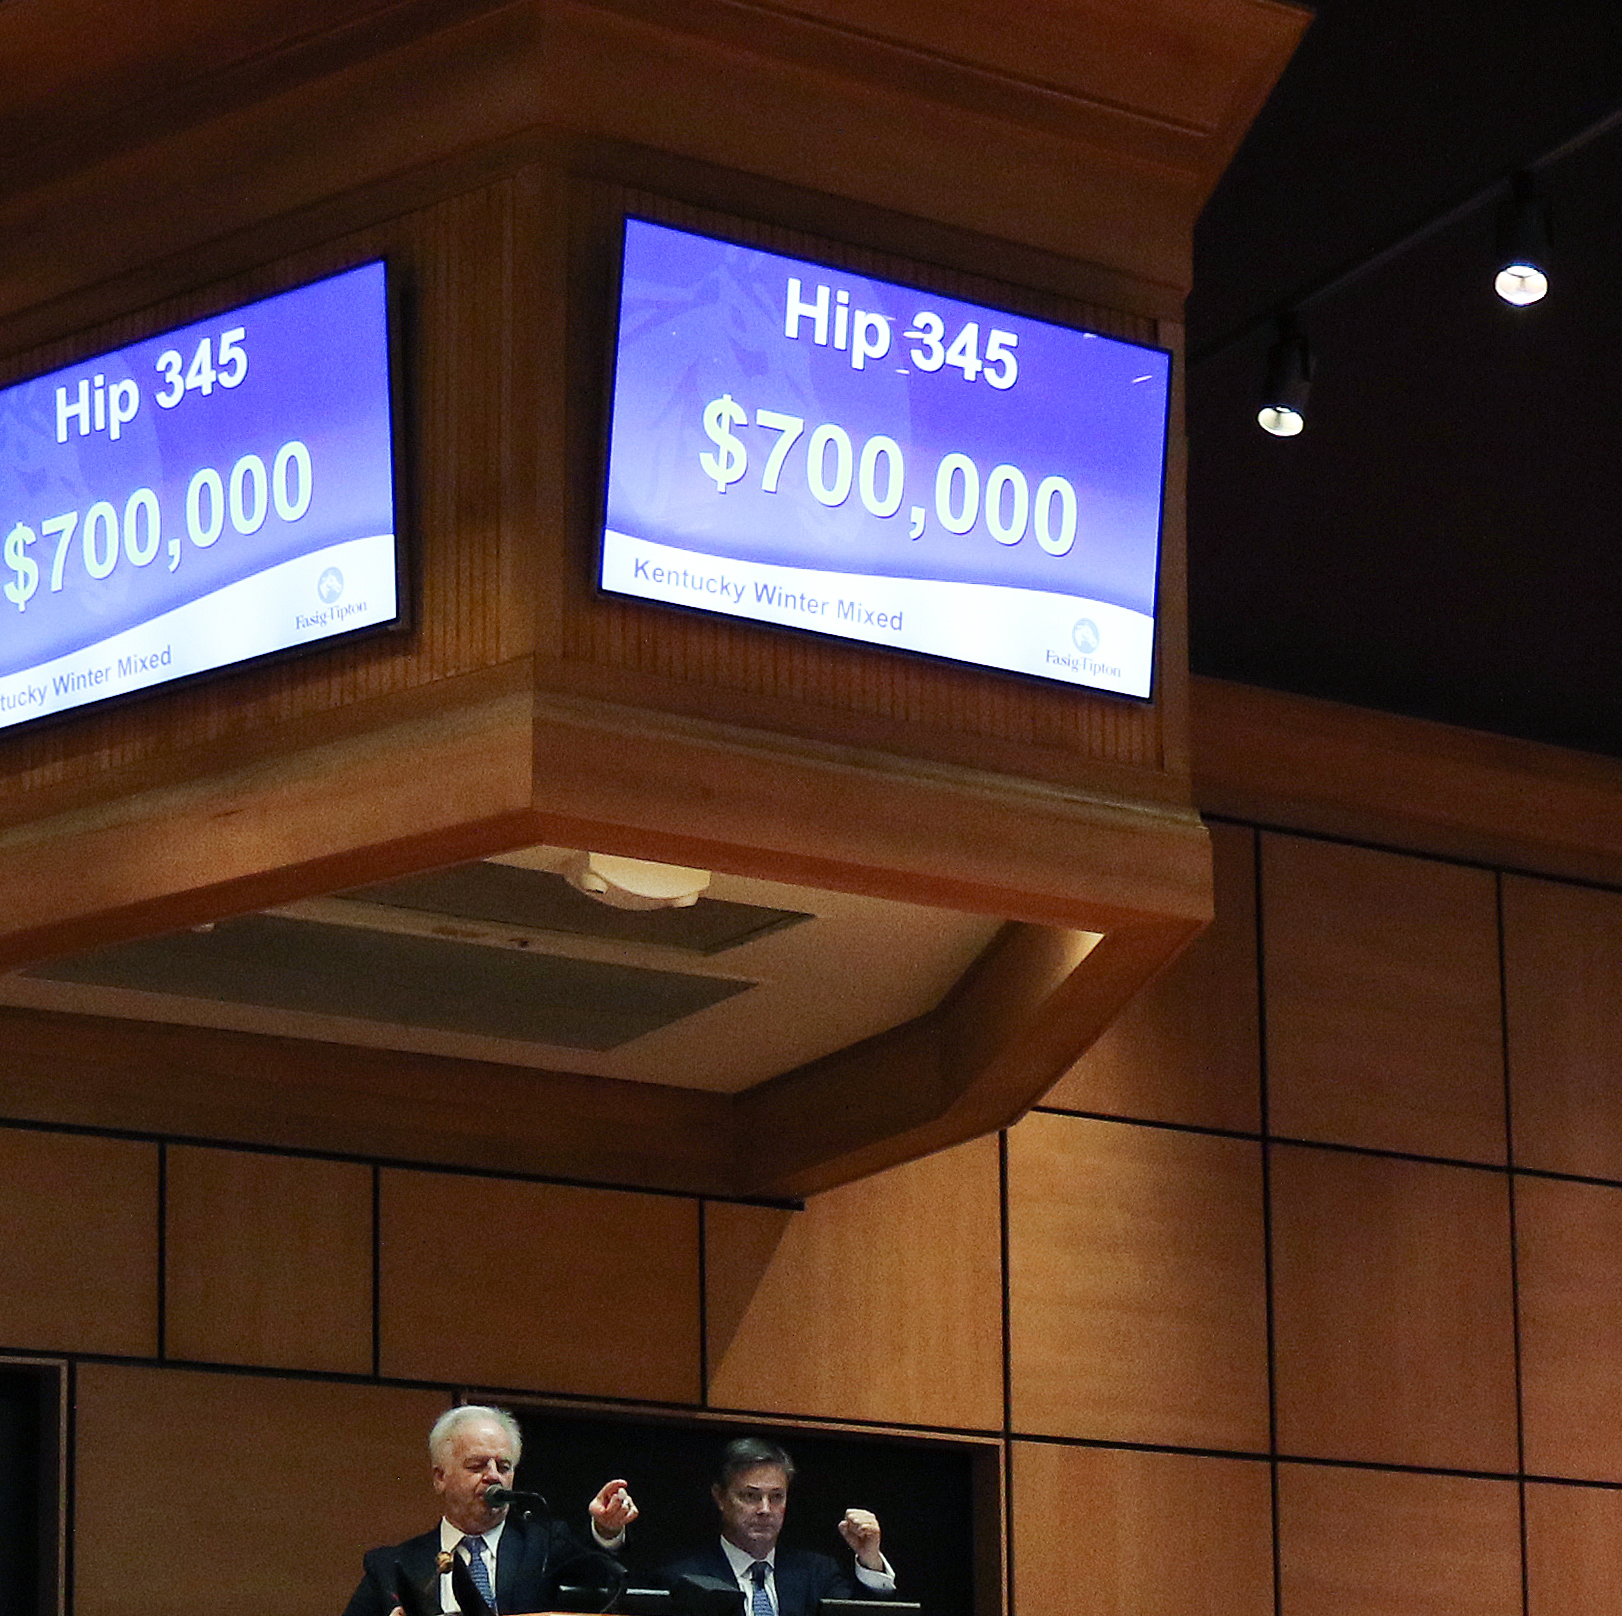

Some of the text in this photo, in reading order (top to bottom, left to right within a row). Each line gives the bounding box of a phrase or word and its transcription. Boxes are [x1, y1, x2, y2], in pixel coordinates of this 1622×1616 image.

[55, 327, 248, 443] Hip 345
[784, 278, 1019, 390] Hip 345
[3, 440, 313, 612] $700,000
[699, 394, 1077, 556] $700,000
[634, 557, 904, 632] Kentucky Winter Mixed
[53, 663, 112, 697] Winter
[118, 645, 172, 678] Mixed
